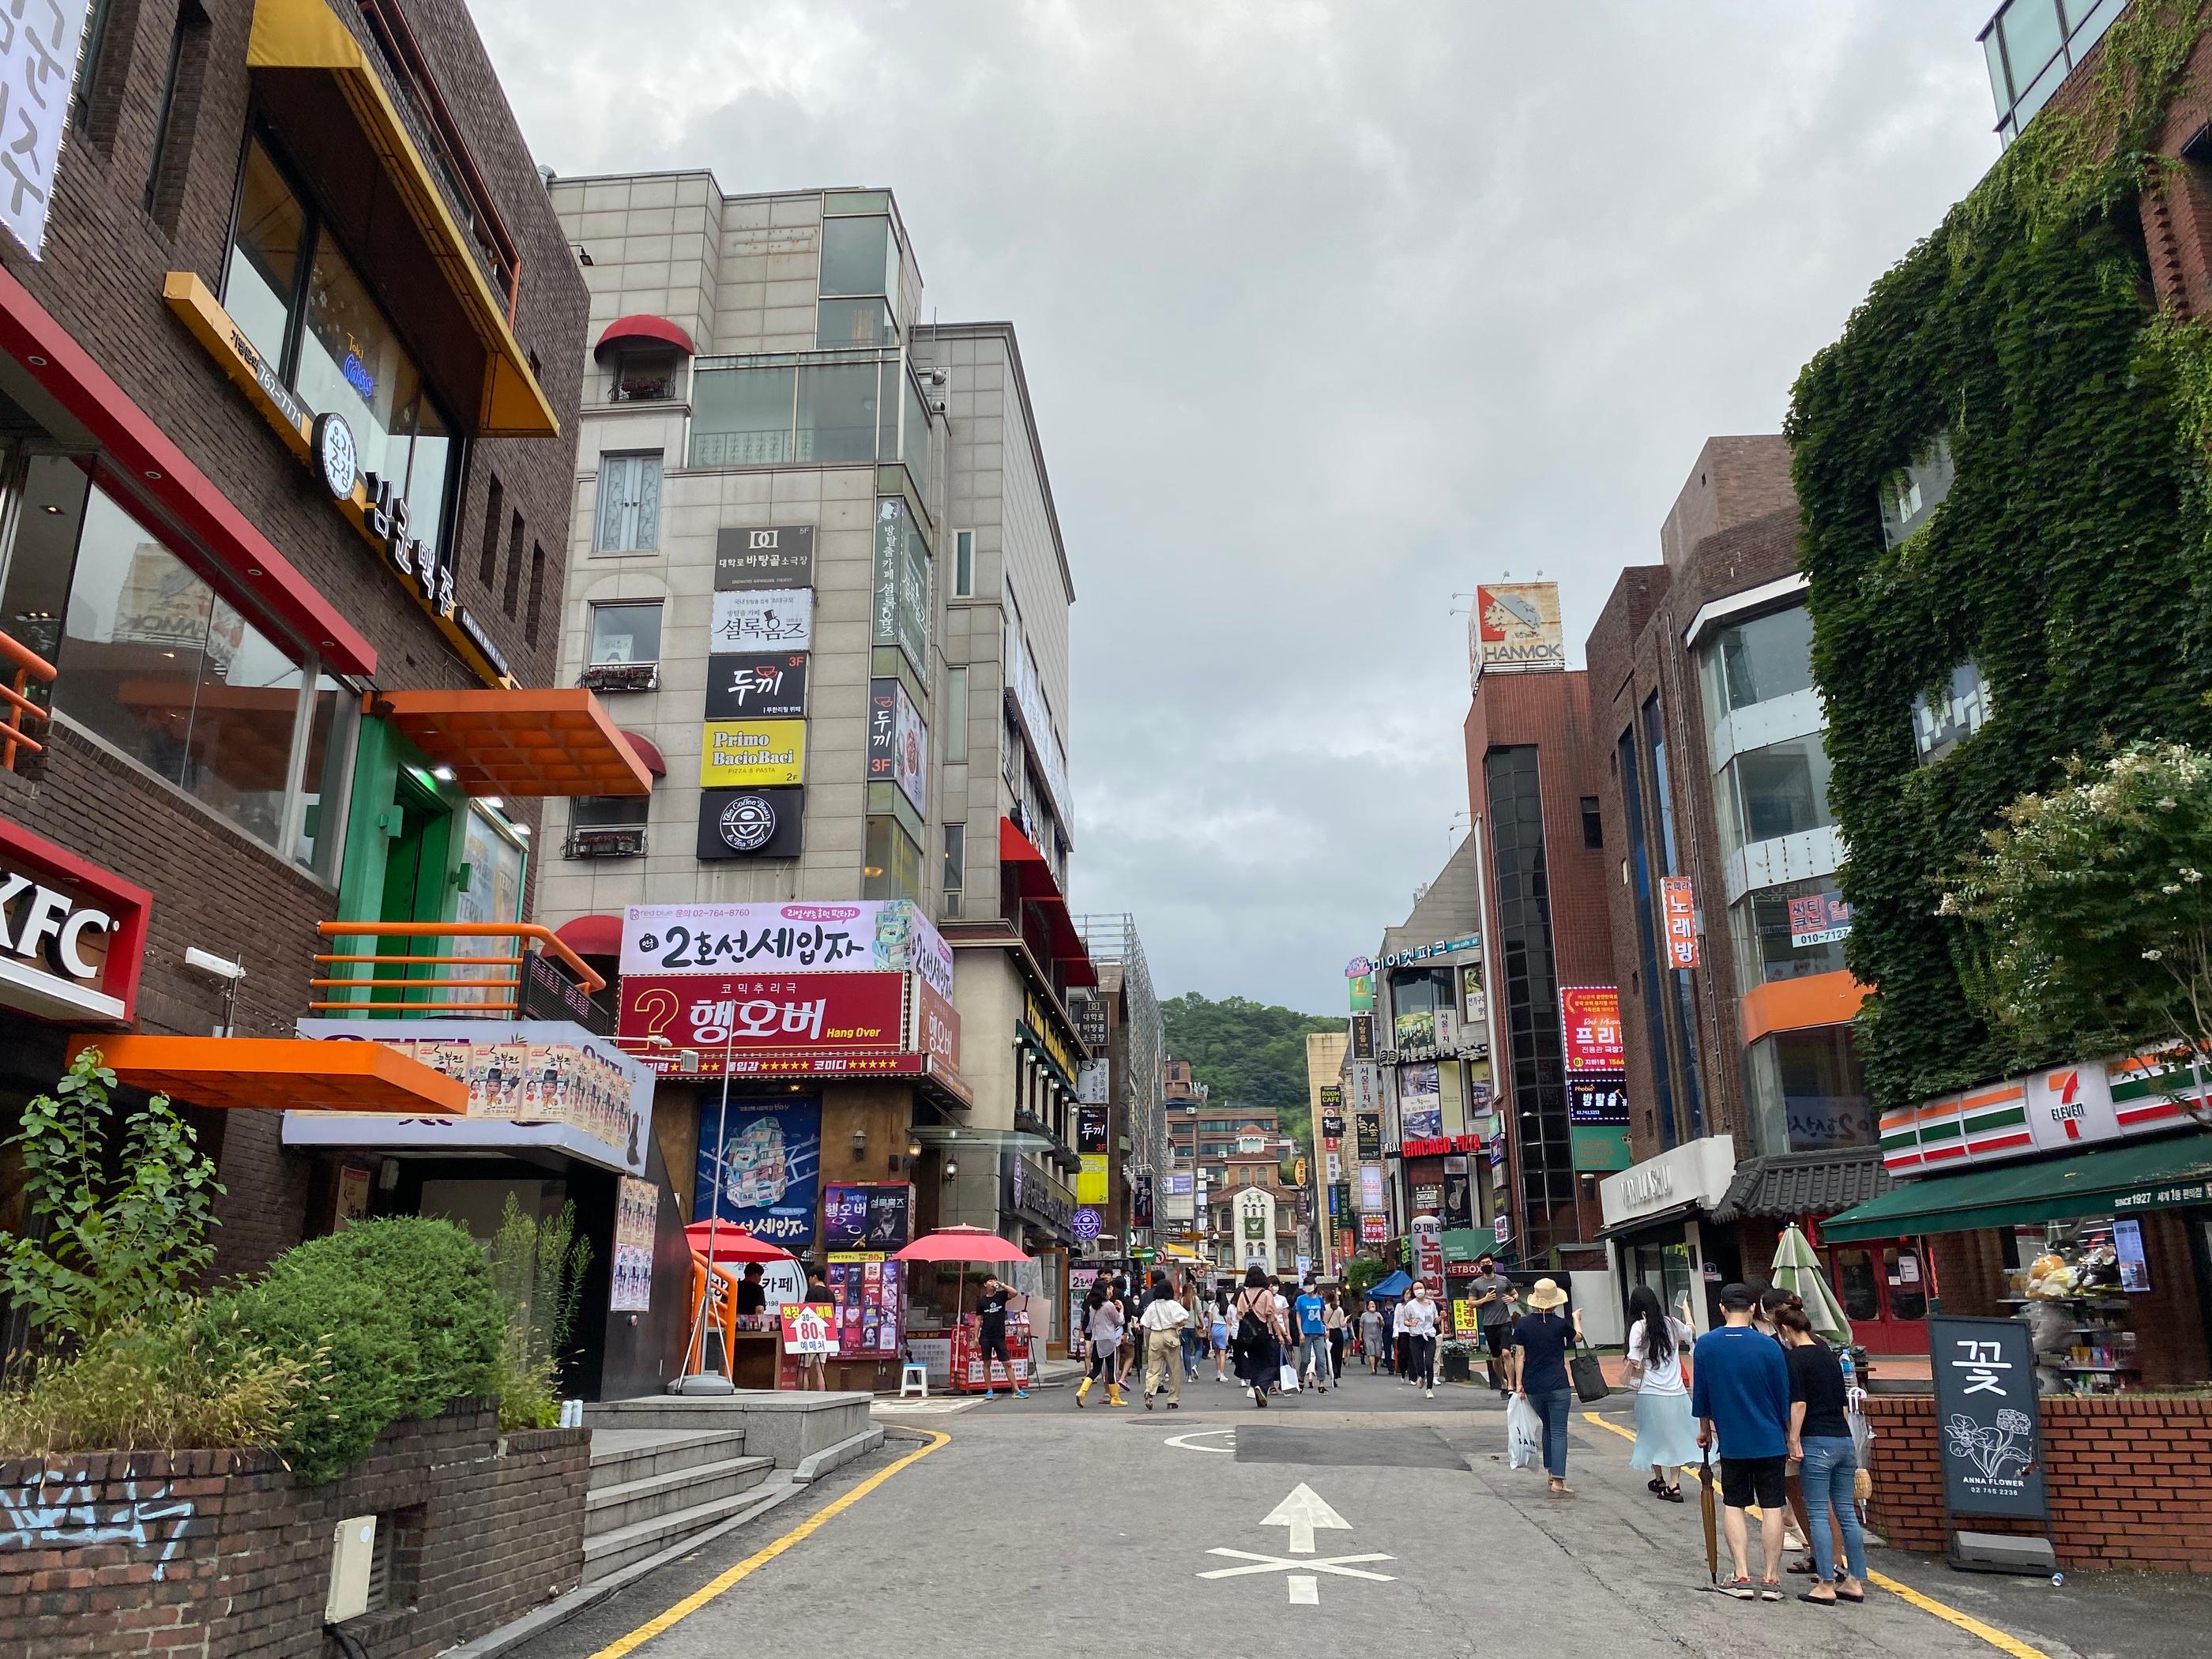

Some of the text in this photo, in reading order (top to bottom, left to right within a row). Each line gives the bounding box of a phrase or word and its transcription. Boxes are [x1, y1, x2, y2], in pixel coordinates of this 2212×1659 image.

[260, 364, 301, 428] 762-7771
[329, 447, 351, 489] 주점
[374, 472, 453, 617] 김군맥주
[719, 555, 808, 568] 대학로 바탕골 소극장
[483, 635, 499, 660] BEER
[1484, 643, 1562, 660] HANMOK
[788, 656, 804, 667] 3F
[728, 669, 784, 707] 두끼
[873, 710, 892, 748] 두끼
[713, 731, 770, 748] Primo
[871, 758, 891, 772] 3F
[786, 773, 798, 782] 2F
[722, 797, 772, 822] The Coffee Bean
[733, 836, 747, 848] Tea
[747, 831, 767, 848] Leaf
[675, 908, 691, 918] 문의
[693, 908, 750, 917] 02-764-8760
[1670, 894, 1694, 962] 노래방
[1372, 940, 1447, 971] 미어켓파크
[690, 998, 827, 1044] 행오버
[1082, 1013, 1105, 1021] 대학로
[826, 1026, 881, 1040] Hang Over
[927, 1010, 953, 1059] 행오버
[1082, 1024, 1105, 1033] 바탕골
[1082, 1033, 1105, 1043] 소극장
[814, 1059, 847, 1072] 코미디
[1360, 1067, 1371, 1103] 서울포차
[1582, 1093, 1617, 1107] 방탈출
[1081, 1123, 1105, 1141] 두끼
[1096, 1143, 1107, 1152] 3F
[1384, 1134, 1481, 1157] REAL CHICAGO PIZZA
[1416, 1192, 1438, 1201] CHICAGO
[2115, 1196, 2132, 1207] SINCE
[2133, 1193, 2151, 1204] 1927
[2183, 1187, 2203, 1198] 편의점
[825, 1202, 867, 1217] 행오버
[1421, 1235, 1444, 1297] 노래방
[782, 1305, 833, 1319] 현장 예매
[1307, 1309, 1321, 1322] 84
[800, 1341, 826, 1351] 예매처
[1951, 1340, 2013, 1396] 꽃
[1962, 1477, 2025, 1488] ANNA FLOWER
